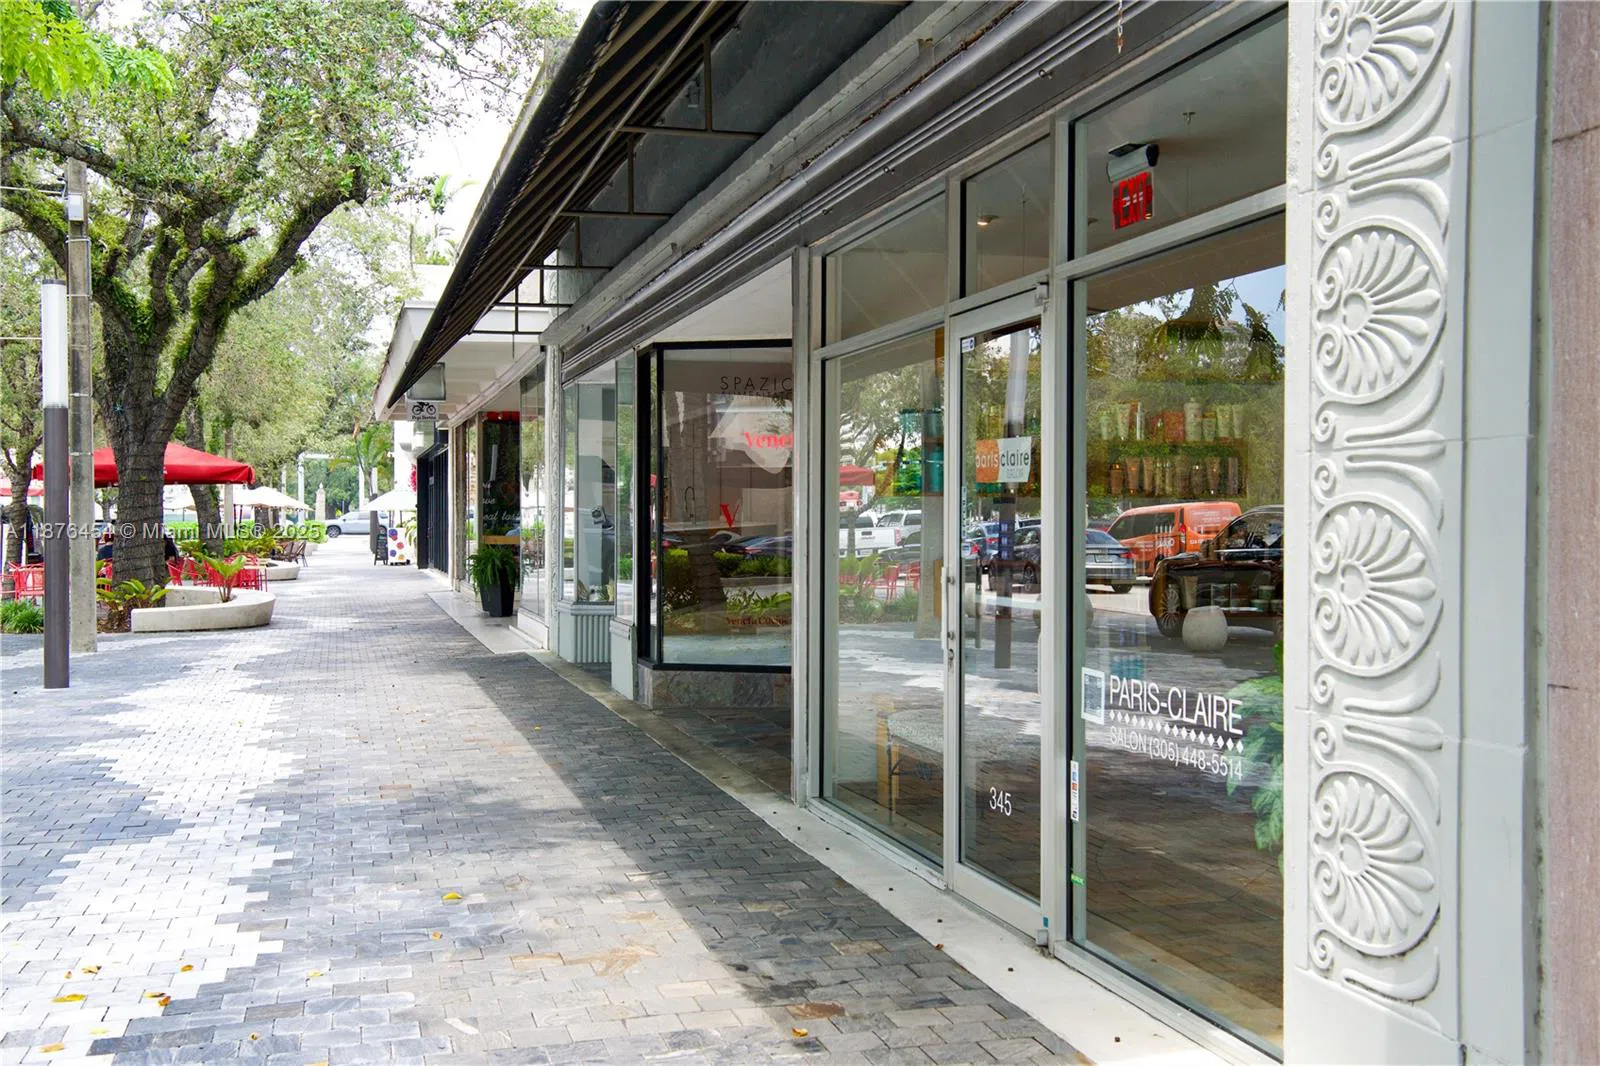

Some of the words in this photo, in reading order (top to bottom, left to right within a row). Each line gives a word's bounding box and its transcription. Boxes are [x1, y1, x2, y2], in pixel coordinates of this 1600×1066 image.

[1117, 173, 1151, 228] EXIT
[1001, 449, 1029, 467] claire
[1110, 675, 1243, 735] PARIS-CLAIRE
[1110, 725, 1147, 752] SALON
[1149, 737, 1180, 767] (305)
[1182, 747, 1243, 782] 448-5514
[989, 786, 1012, 817] 345
